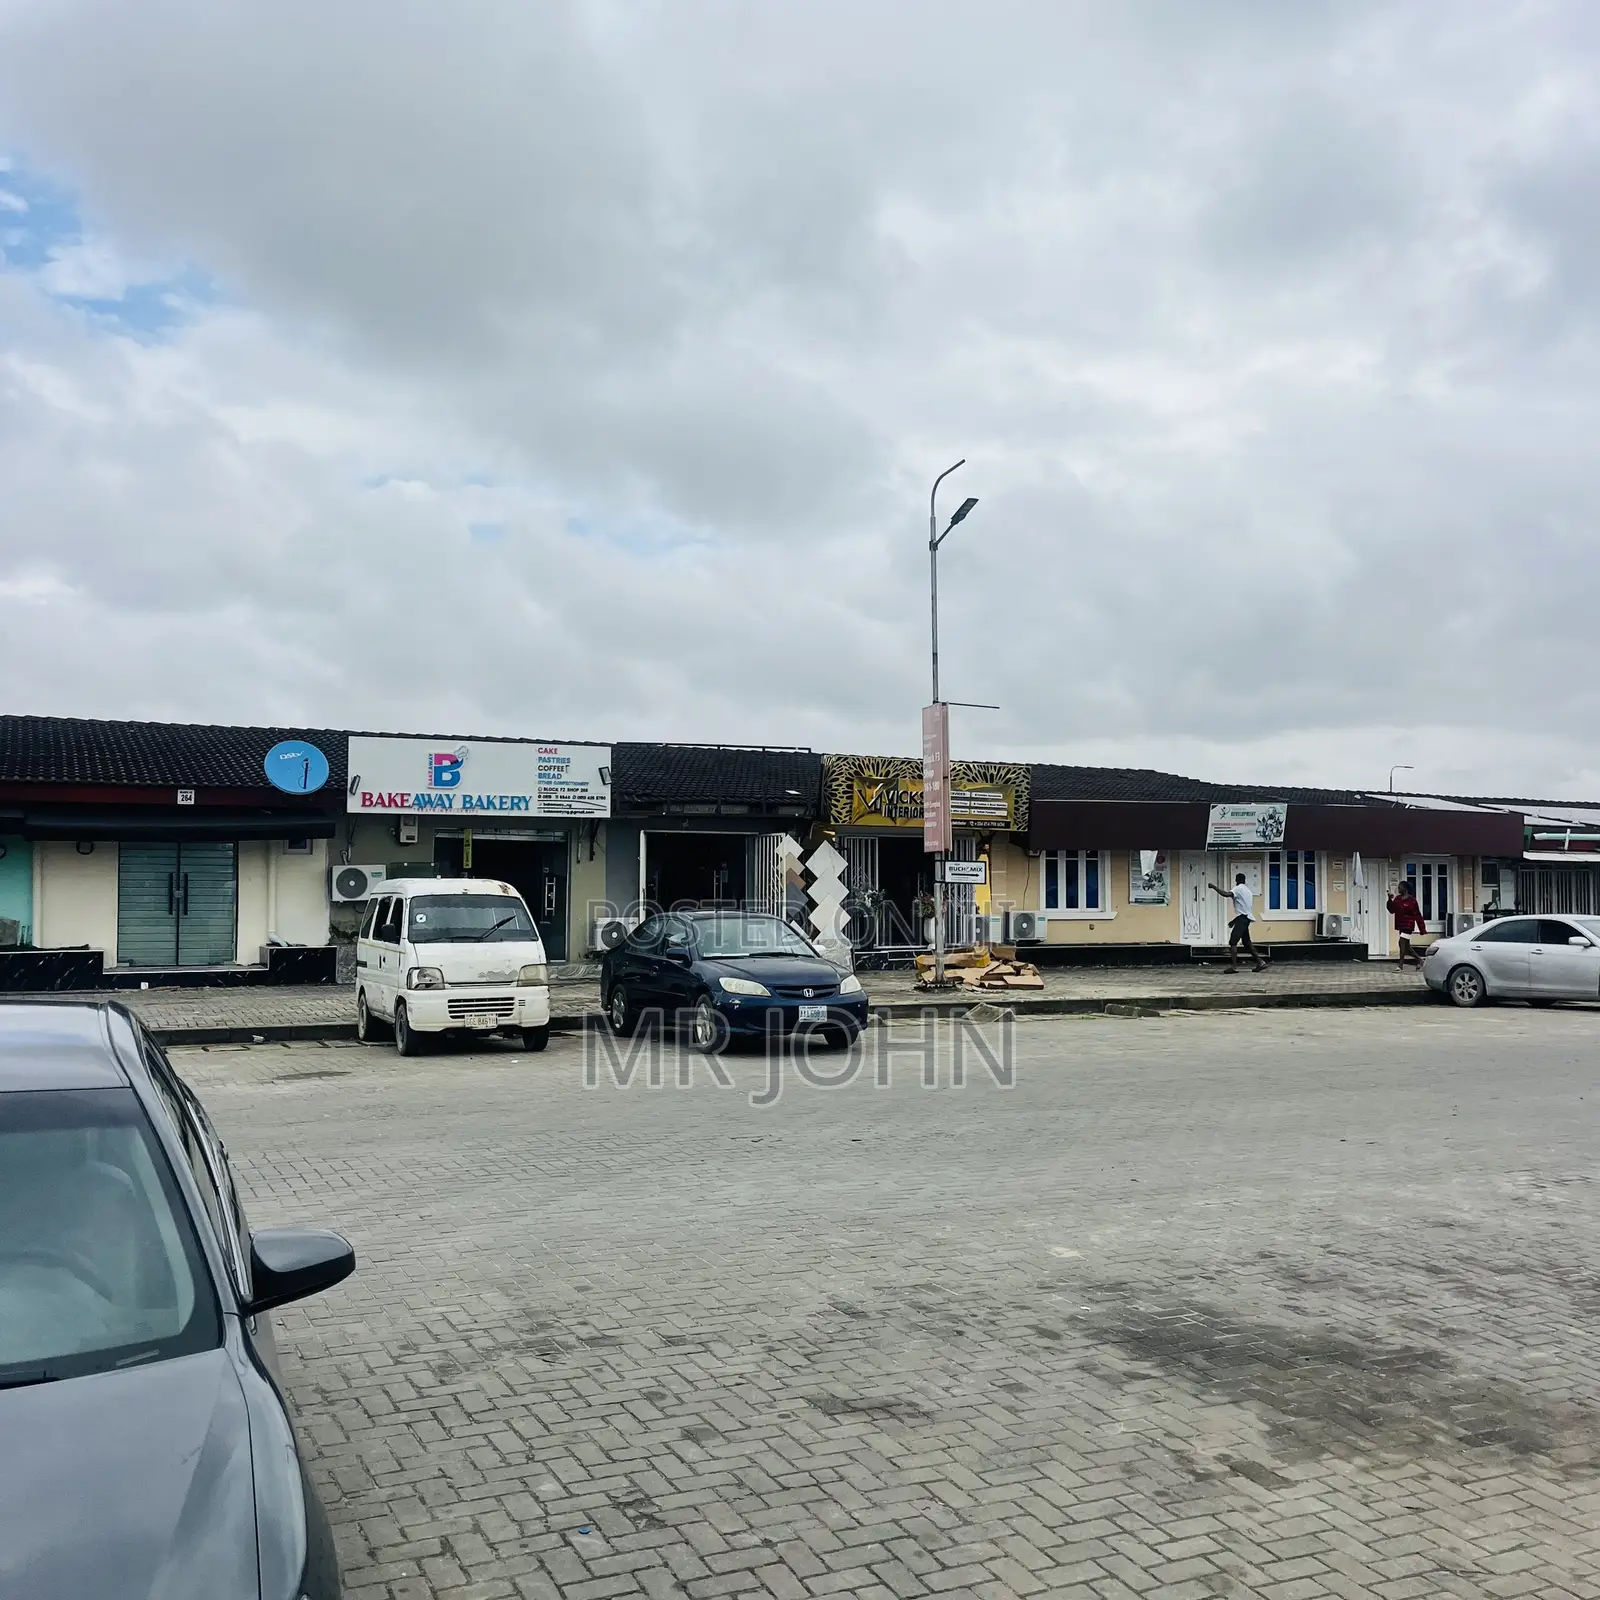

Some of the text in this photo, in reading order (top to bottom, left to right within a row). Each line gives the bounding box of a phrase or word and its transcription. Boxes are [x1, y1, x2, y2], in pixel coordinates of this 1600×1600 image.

[538, 747, 558, 755] CAKE
[180, 794, 192, 802] 264
[361, 791, 532, 811] BAKEAWAY BAKERY
